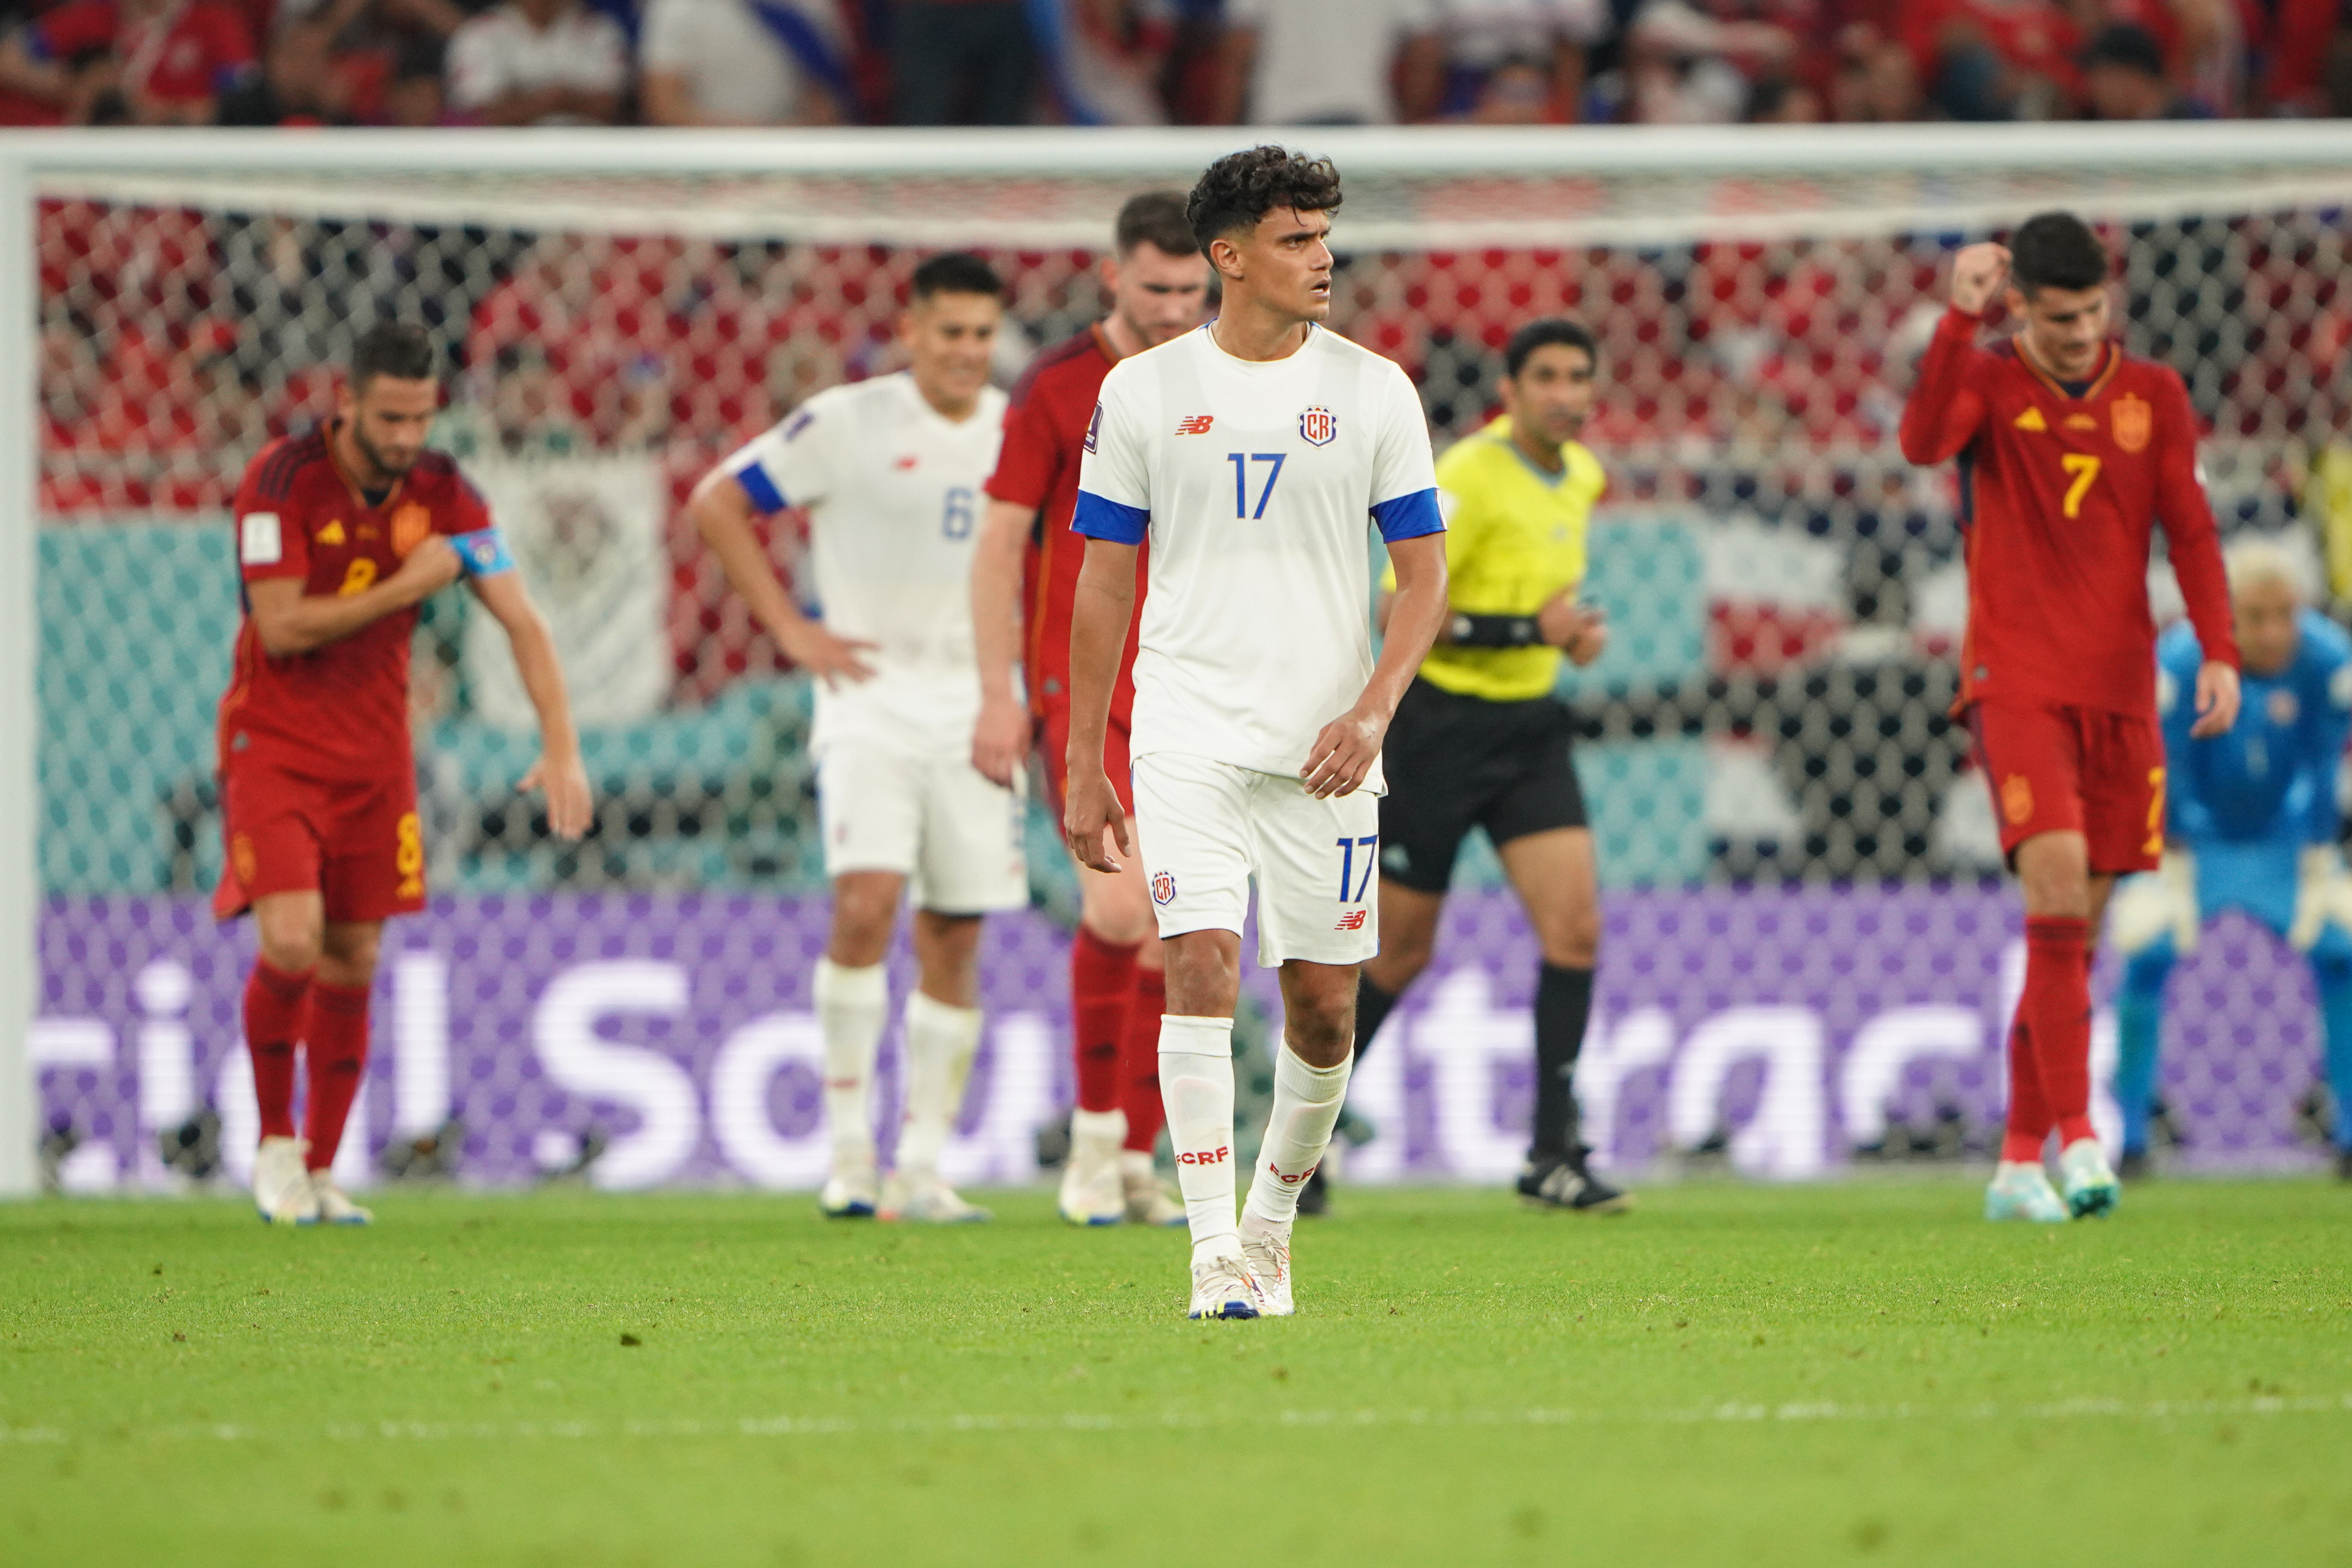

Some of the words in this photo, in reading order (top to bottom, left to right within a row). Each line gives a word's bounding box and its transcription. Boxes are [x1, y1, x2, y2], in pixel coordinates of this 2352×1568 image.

[1307, 414, 1329, 440] CR
[942, 486, 974, 541] 6
[1227, 453, 1288, 520] 17
[2061, 453, 2101, 518] 7
[2147, 766, 2167, 831] 7
[397, 811, 422, 873] 8
[1336, 834, 1378, 903] 17
[1156, 878, 1171, 900] CR
[1176, 1146, 1228, 1166] FCRF
